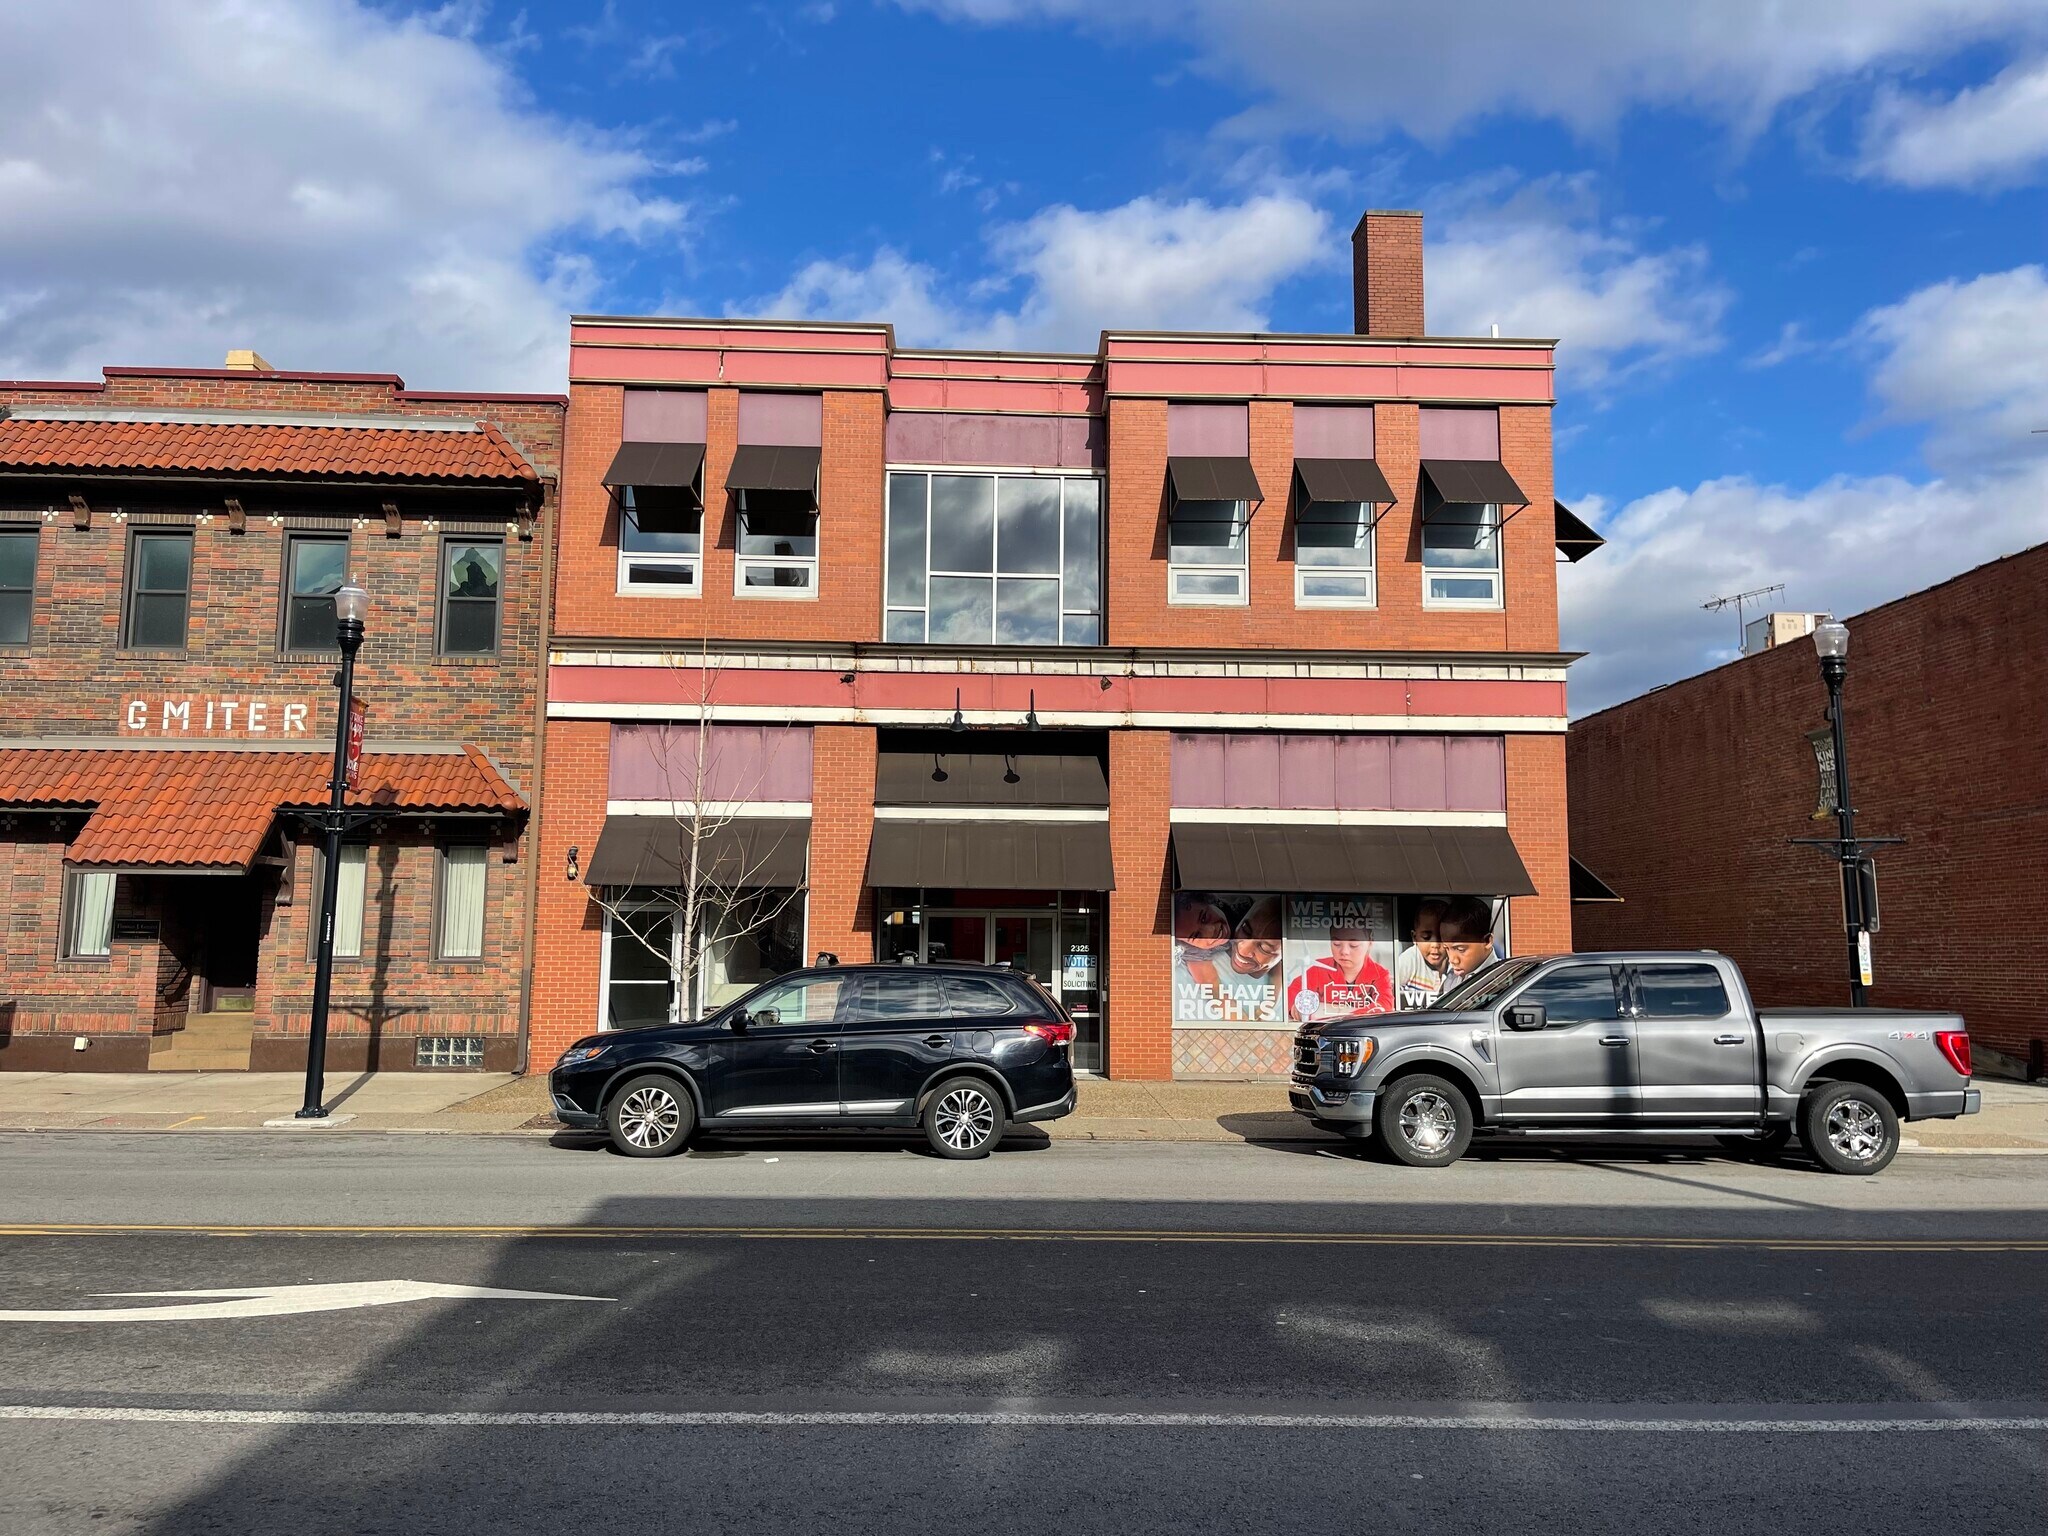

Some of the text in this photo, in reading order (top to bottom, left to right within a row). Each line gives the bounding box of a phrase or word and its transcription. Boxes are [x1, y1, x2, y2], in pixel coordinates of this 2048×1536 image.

[127, 700, 308, 732] GMITER
[1819, 761, 1836, 772] NES
[1821, 779, 1837, 789] AUL
[1820, 788, 1837, 799] LAN
[1290, 901, 1384, 917] WE HAVE
[1290, 916, 1389, 930] RESOURCES.
[1070, 944, 1090, 953] 2325
[1064, 956, 1096, 967] NOTICE
[1075, 970, 1084, 978] NO
[1063, 980, 1097, 988] SOLICITING
[1178, 983, 1276, 1000] WE HAVE
[1331, 990, 1362, 1000] PEAL
[1178, 999, 1281, 1021] RIGHTS.
[1331, 1000, 1371, 1009] CENTER
